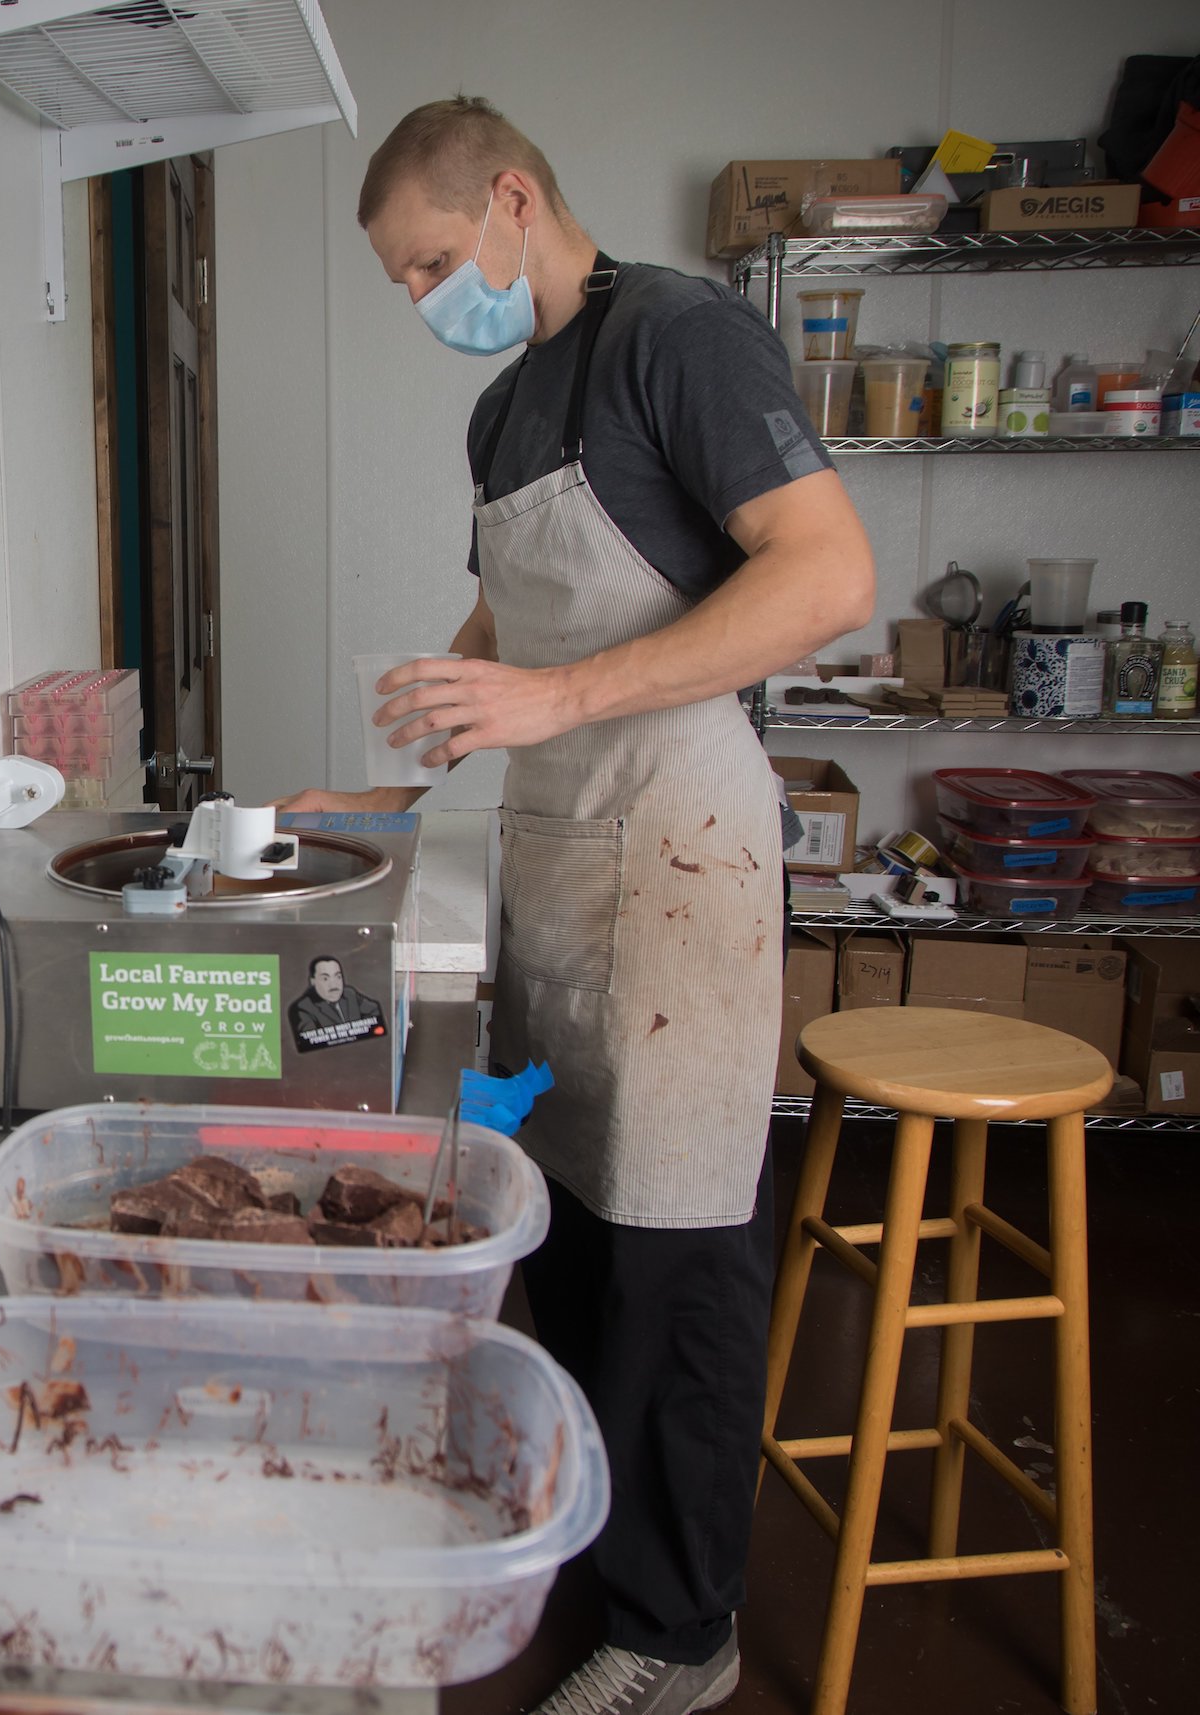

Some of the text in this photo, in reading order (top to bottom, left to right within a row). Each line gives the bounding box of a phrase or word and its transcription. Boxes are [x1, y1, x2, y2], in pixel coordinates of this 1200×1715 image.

[1037, 196, 1105, 213] AEGIS
[1162, 668, 1187, 677] SANTA
[1164, 676, 1185, 685] CRUZ
[100, 963, 272, 985] Local Farmers
[102, 991, 273, 1016] Grow My Food
[201, 1021, 266, 1033] GROW
[193, 1040, 277, 1072] CHA
